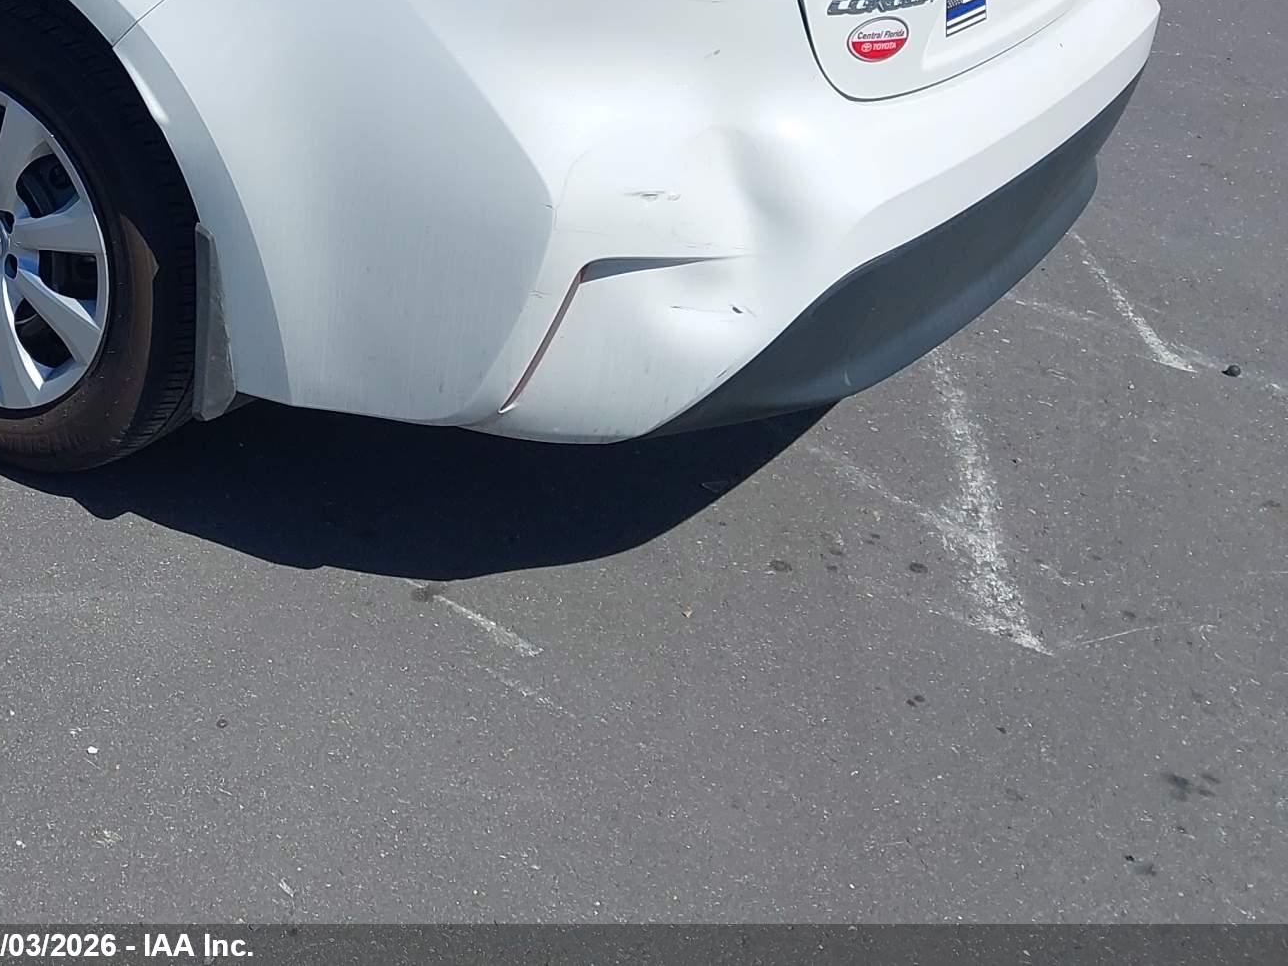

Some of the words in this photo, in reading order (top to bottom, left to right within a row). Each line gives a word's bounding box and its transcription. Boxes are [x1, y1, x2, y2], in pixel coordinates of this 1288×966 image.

[857, 30, 883, 40] Central
[884, 29, 905, 38] Florida
[873, 42, 897, 50] TOYOTA
